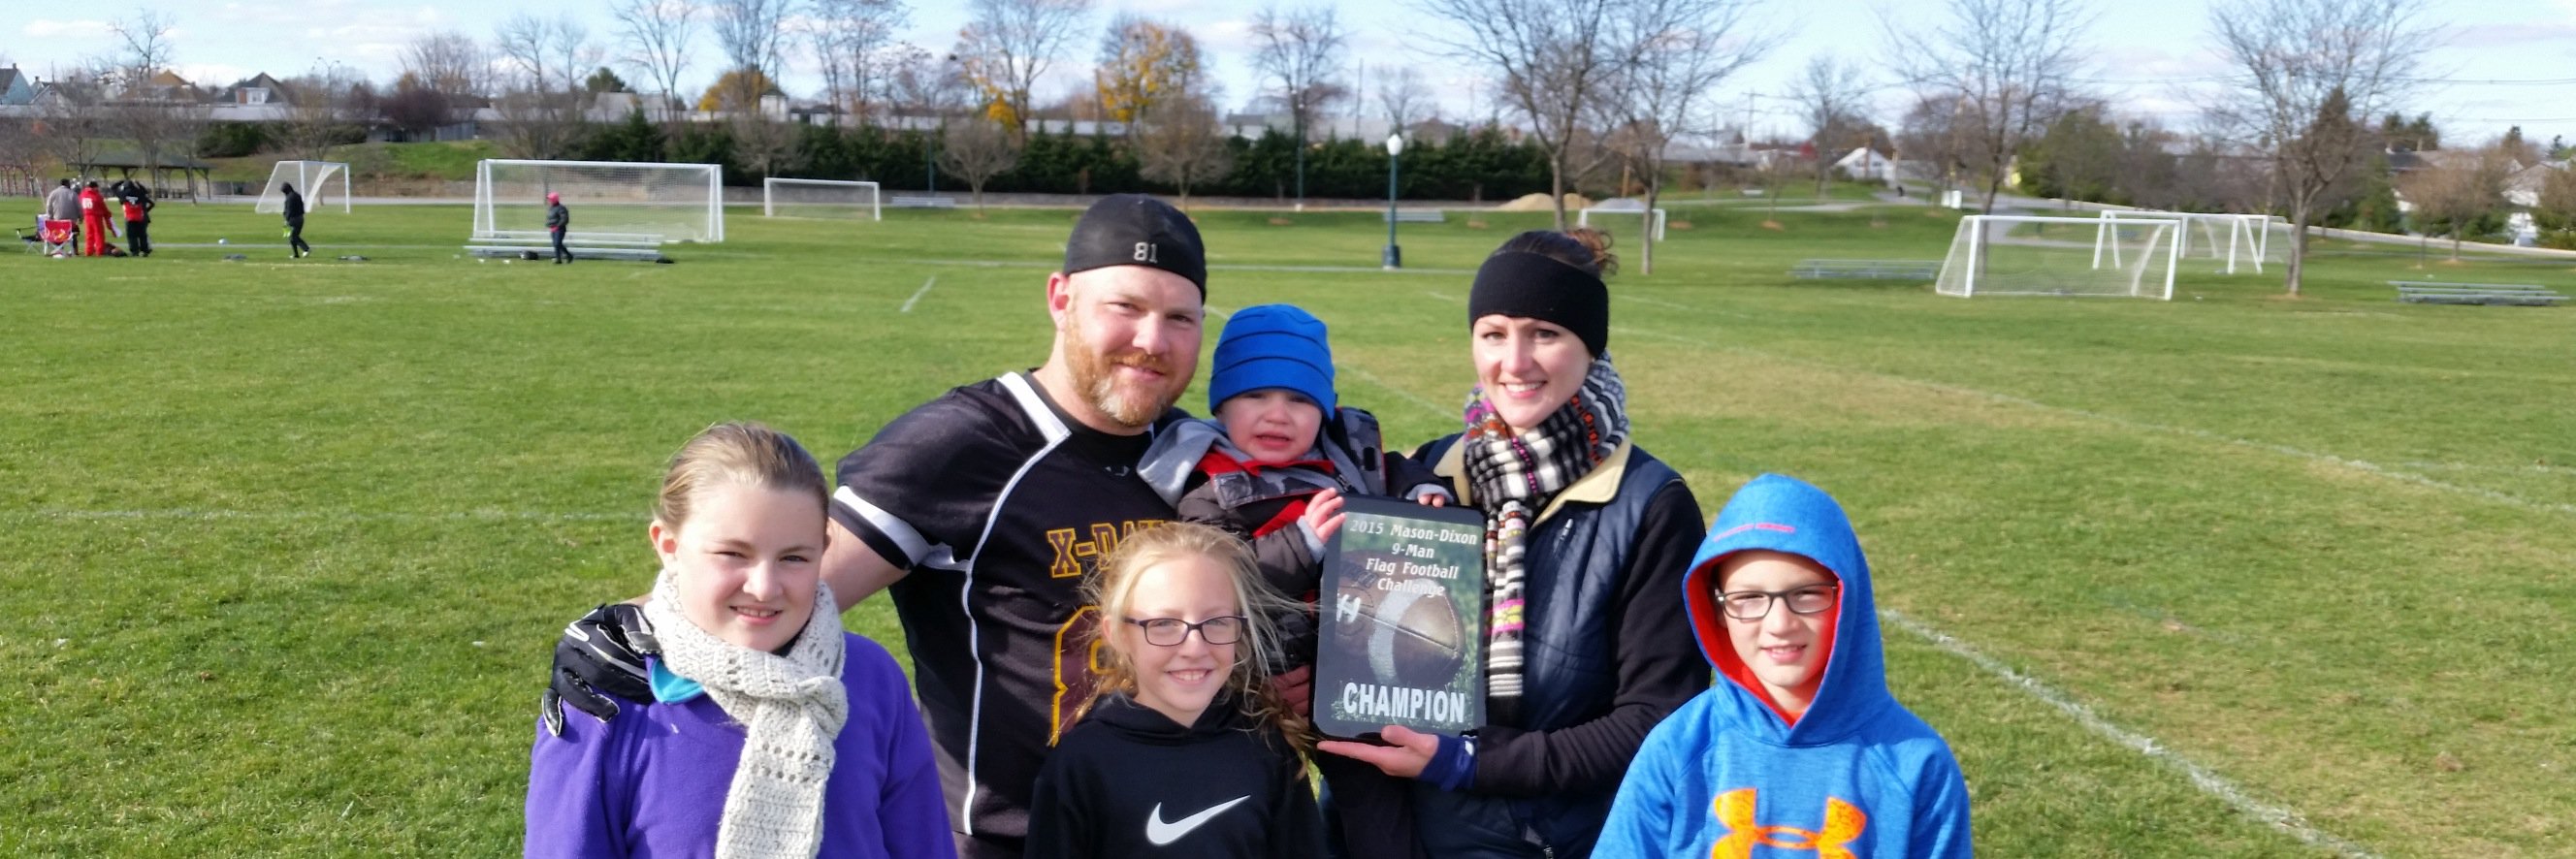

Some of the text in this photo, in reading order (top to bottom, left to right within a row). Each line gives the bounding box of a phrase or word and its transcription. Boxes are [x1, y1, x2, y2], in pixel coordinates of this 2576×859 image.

[1134, 241, 1158, 263] 81
[1349, 519, 1478, 545] 2015 Mason-Dixon
[1392, 543, 1434, 559] 9-Man
[1366, 558, 1460, 579] Flag Football
[1377, 578, 1445, 598] Challenge
[1343, 682, 1465, 723] CHAMPION
